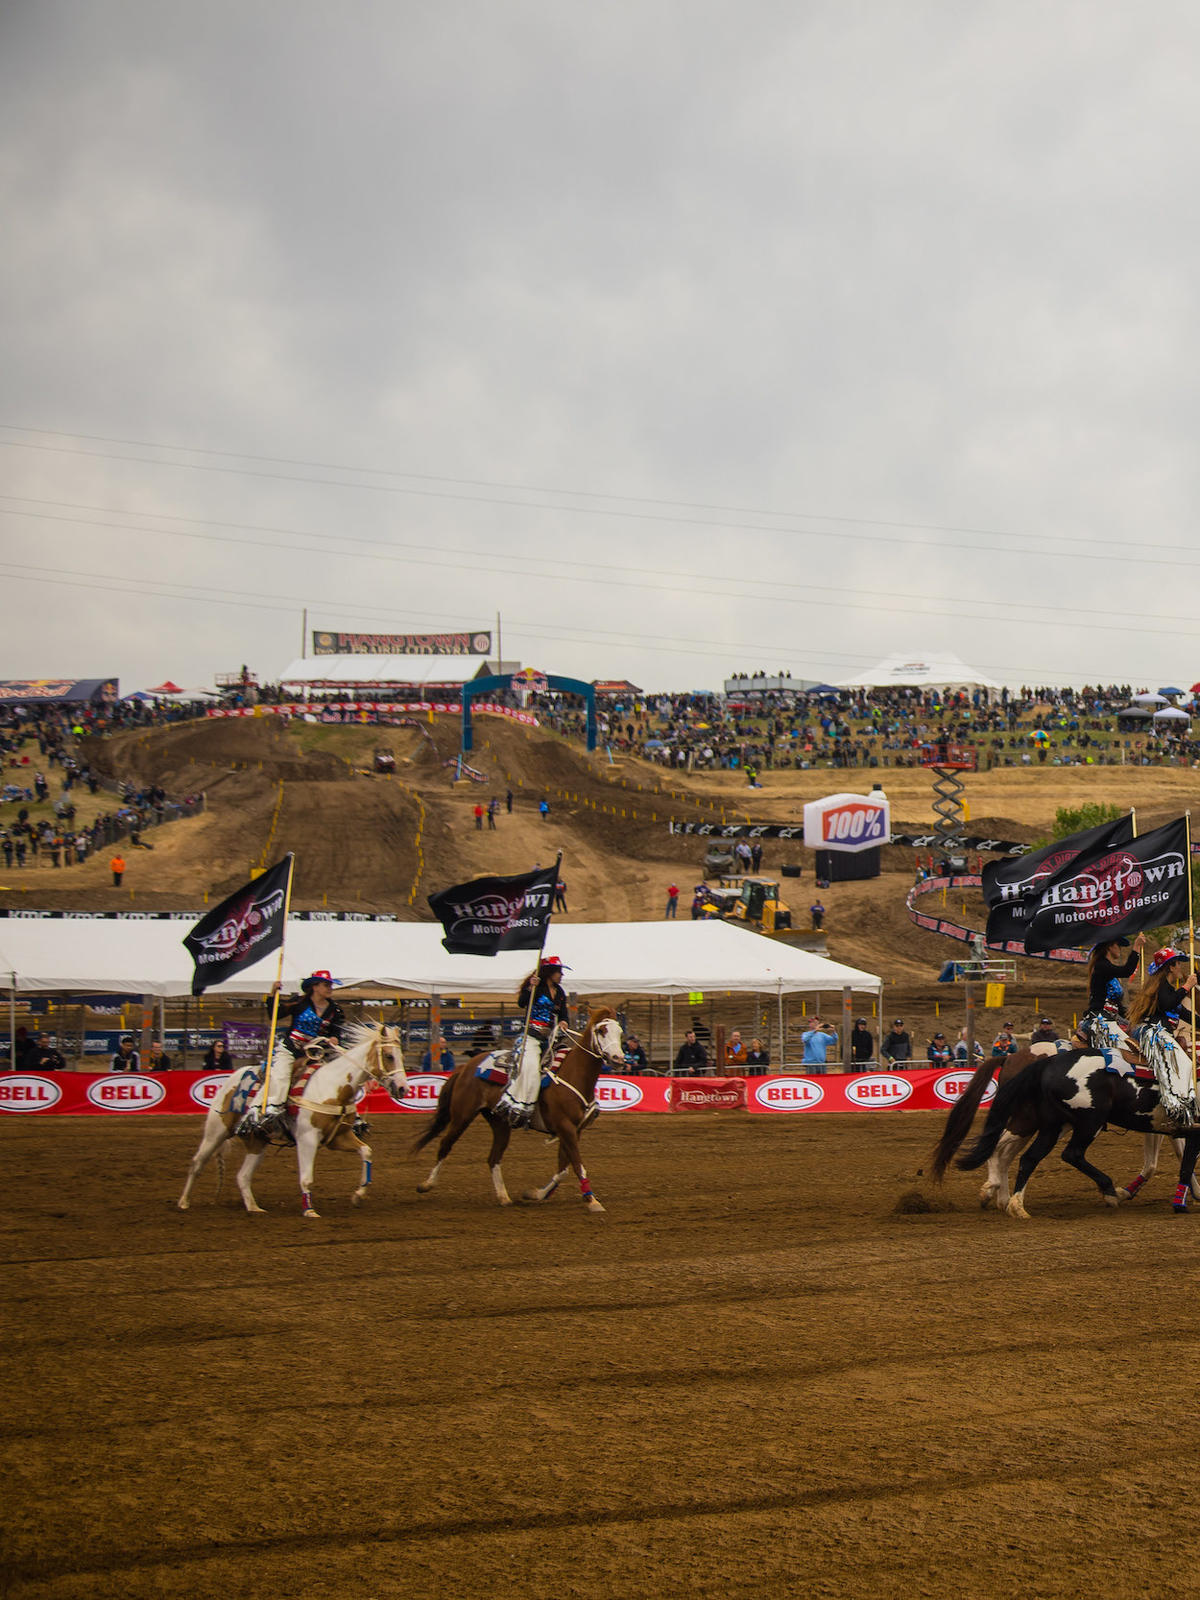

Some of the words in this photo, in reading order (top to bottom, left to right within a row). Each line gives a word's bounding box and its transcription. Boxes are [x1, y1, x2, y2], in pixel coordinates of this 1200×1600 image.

[338, 633, 470, 647] HANGTOWN
[828, 809, 882, 839] 100%
[1124, 891, 1170, 911] Classic
[1055, 905, 1121, 925] Motocross
[0, 1086, 49, 1101] BELL
[101, 1086, 153, 1100] BELL
[404, 1086, 440, 1099] BEL
[767, 1087, 813, 1101] BELL
[856, 1083, 902, 1098] BELL
